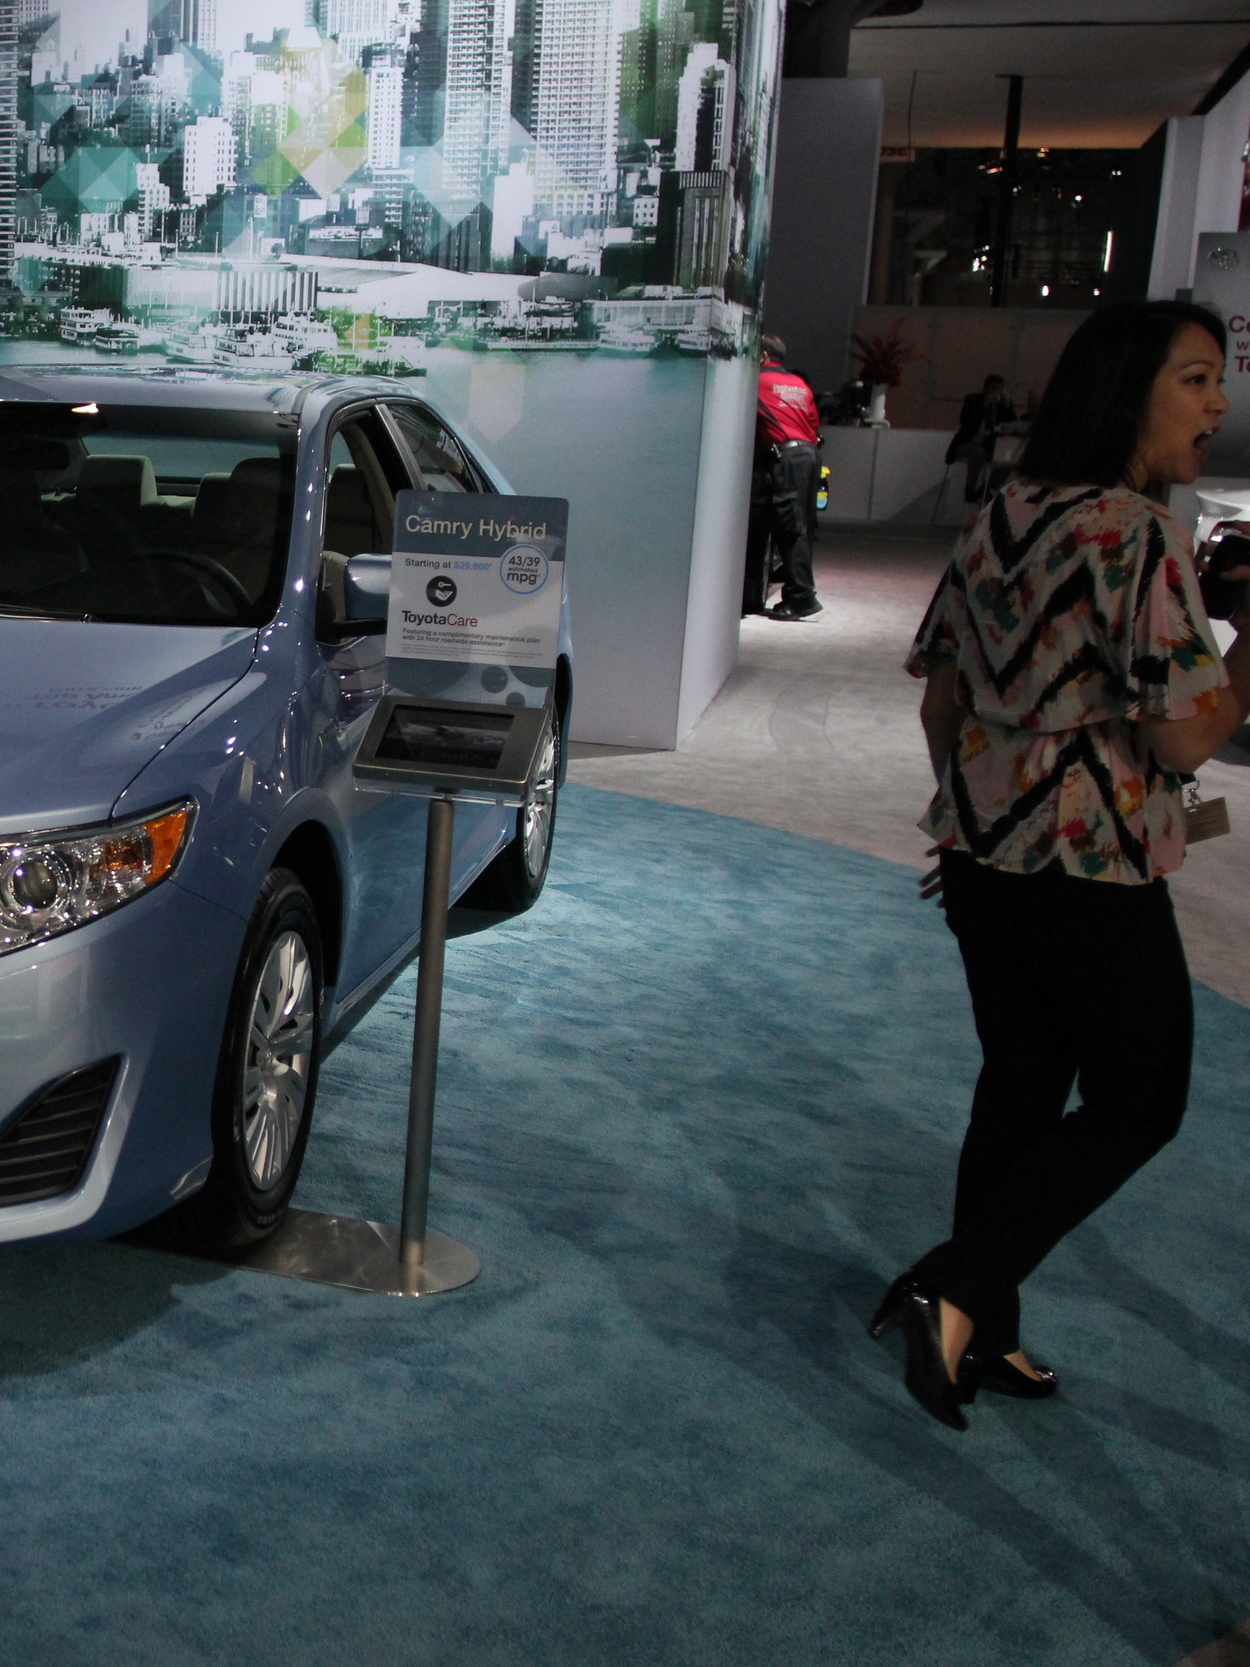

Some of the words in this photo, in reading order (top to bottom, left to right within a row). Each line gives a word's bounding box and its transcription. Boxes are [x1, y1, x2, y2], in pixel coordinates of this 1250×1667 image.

[405, 514, 473, 540] Camry
[479, 518, 547, 542] Hybrid
[405, 558, 441, 569] Starting
[508, 555, 541, 567] 43/39
[401, 610, 478, 628] ToyotaCare
[402, 627, 431, 636] Featuring
[438, 631, 484, 640] complimentary
[485, 634, 525, 642] maintenance
[441, 637, 468, 645] roadside
